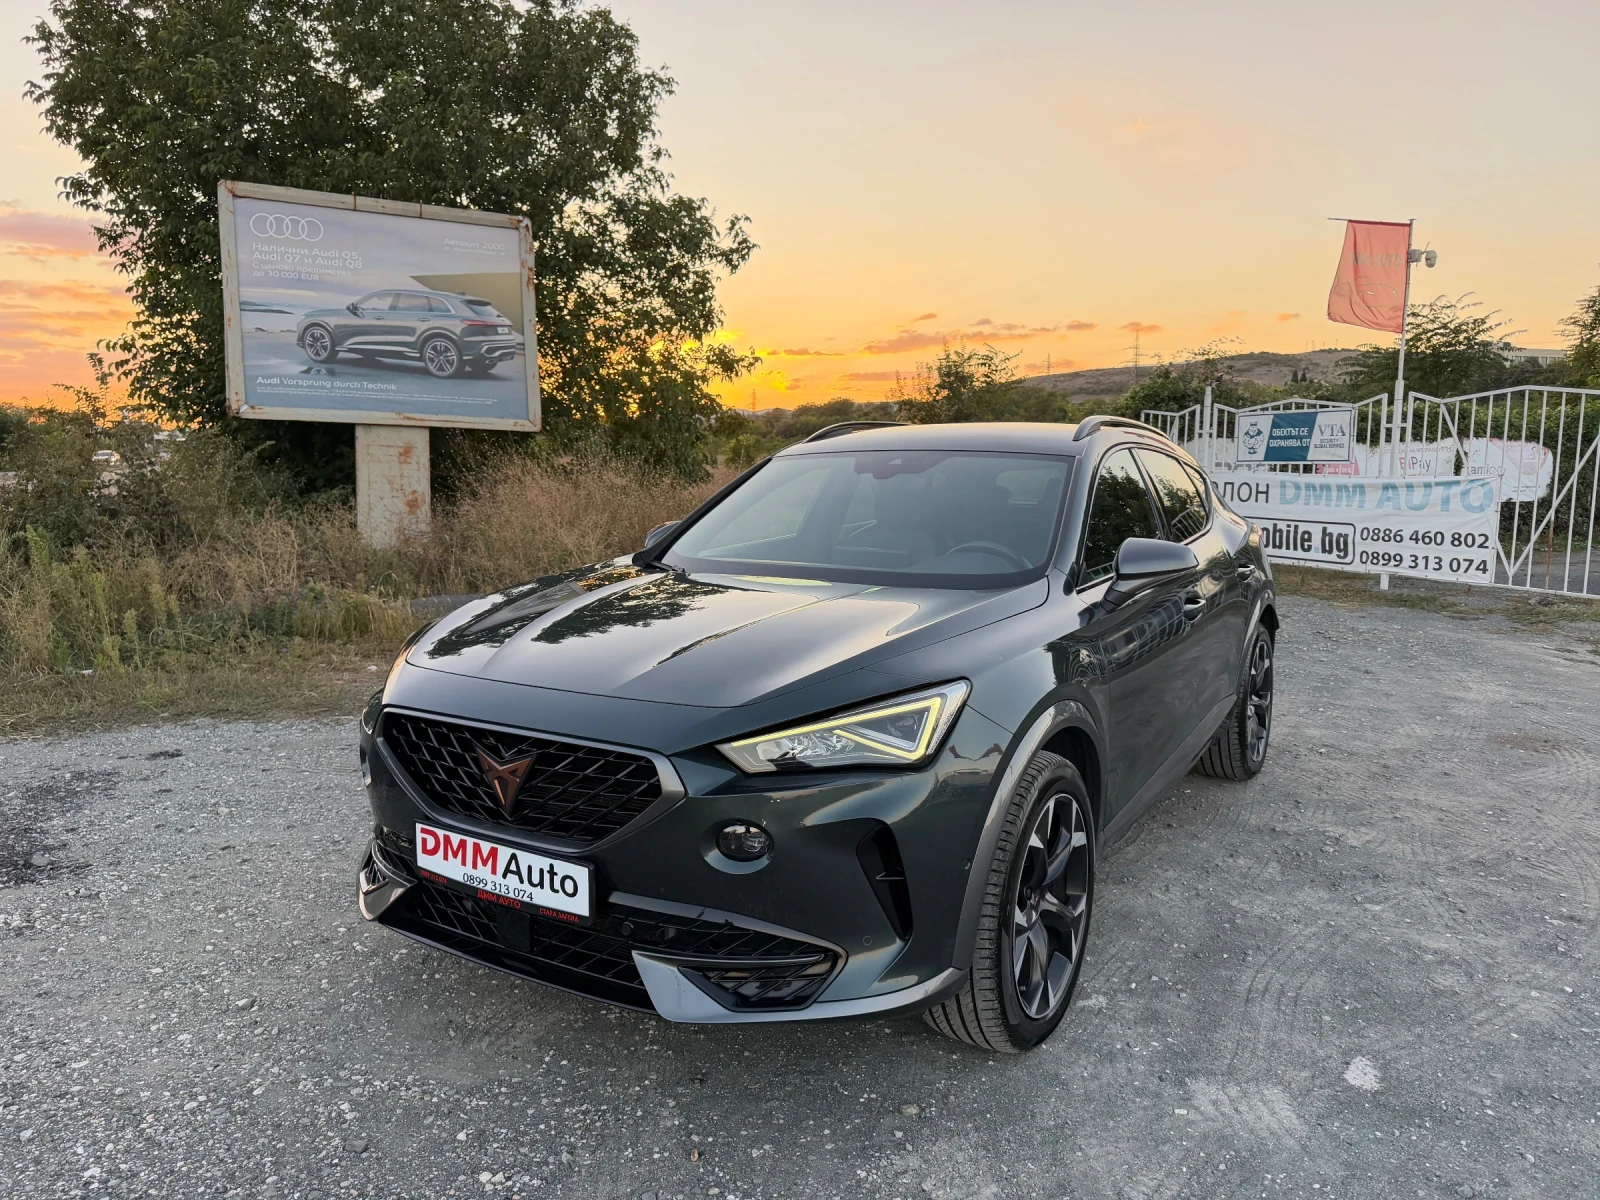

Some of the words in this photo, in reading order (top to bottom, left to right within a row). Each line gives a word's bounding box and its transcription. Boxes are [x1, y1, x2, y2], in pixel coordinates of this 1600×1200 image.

[252, 242, 308, 255] Налични
[311, 247, 339, 258] Audi
[342, 250, 362, 261] Q5,
[482, 241, 506, 251] 2000
[252, 251, 281, 261] Audi
[284, 253, 301, 263] Q7
[315, 257, 343, 267] Audi
[345, 259, 363, 269] Q8
[261, 263, 295, 271] ценово
[296, 266, 352, 277] предимство
[267, 270, 279, 278] 30
[281, 271, 299, 279] 000
[301, 272, 320, 281] EUR
[256, 376, 280, 384] Audi
[282, 377, 332, 388] Vorsprung
[333, 380, 361, 389] durch
[362, 381, 398, 391] Technik
[1272, 428, 1299, 437] ОБЕКТЪТ
[1300, 427, 1309, 436] СЕ
[1317, 423, 1347, 437] VTA
[1269, 439, 1302, 448] ОХРАНЯВА
[1302, 438, 1311, 447] ОТ
[1279, 479, 1367, 509] DMM
[1375, 478, 1495, 514] AUTO
[1261, 522, 1350, 560] obile.bg
[1360, 526, 1404, 544] 0886
[1408, 529, 1445, 547] 460
[1450, 532, 1490, 550] 802
[1359, 550, 1404, 568] 0899
[1408, 554, 1443, 571] 313
[1448, 557, 1489, 575] 074
[462, 872, 488, 888] 0899
[490, 880, 510, 895] 313
[513, 887, 534, 902] 074
[477, 889, 497, 902] ДММ
[499, 896, 521, 910] АУТО
[539, 907, 557, 918] СТАРА
